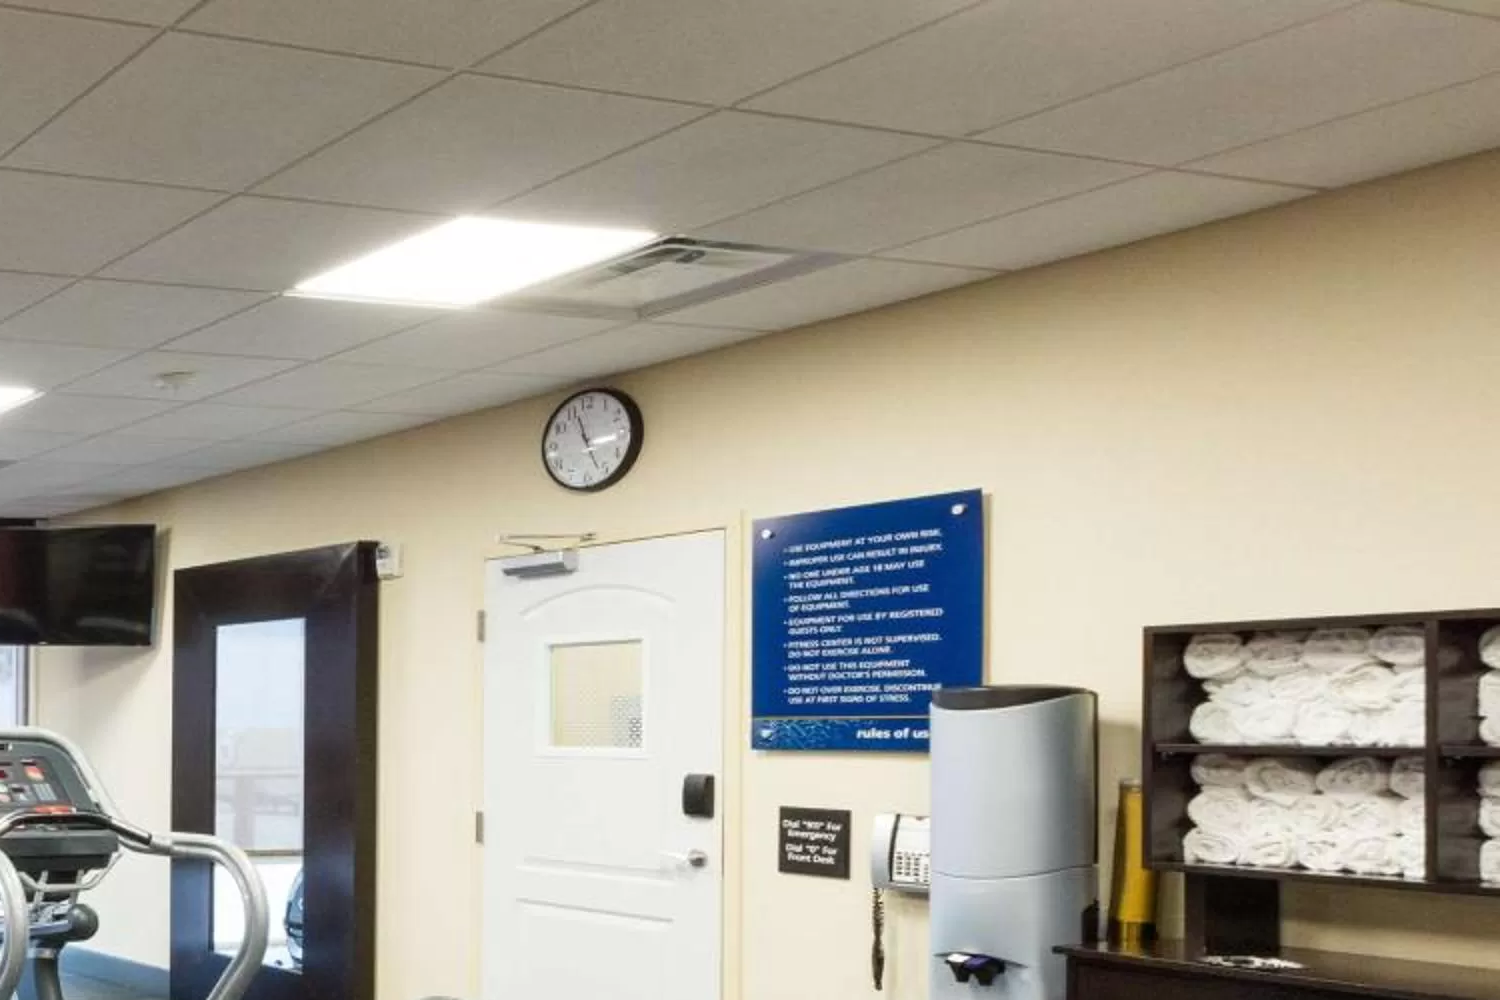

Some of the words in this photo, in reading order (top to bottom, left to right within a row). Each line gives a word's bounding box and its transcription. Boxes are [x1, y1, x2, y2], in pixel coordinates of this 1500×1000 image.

[581, 396, 593, 411] 12
[603, 398, 608, 412] 1
[567, 405, 577, 421] 11
[555, 421, 567, 435] 10
[788, 545, 803, 553] USE
[805, 539, 852, 551] EQUIPMENT
[854, 537, 865, 545] AT
[867, 534, 893, 544] YOUR
[894, 531, 918, 541] OWN
[788, 555, 828, 567] IMPROPER
[830, 553, 845, 562] USE
[846, 551, 865, 561] CAN
[866, 548, 896, 558] RESULT
[898, 547, 908, 555] IN
[803, 570, 820, 579] ONE
[821, 567, 850, 577] UNDER
[852, 565, 870, 574] AGE
[873, 563, 883, 572] 18
[884, 561, 906, 571] MAY
[907, 559, 925, 569] USE
[788, 581, 804, 590] THE
[788, 592, 823, 603] FOLLOW
[823, 591, 838, 600] ALL
[840, 586, 890, 598] DIRECTIONS
[892, 585, 910, 594] FOR
[911, 583, 930, 592] USE
[788, 604, 799, 613] OF
[788, 615, 836, 626] EQUIPMENT
[837, 613, 854, 623] FOR
[856, 612, 872, 621] USE
[875, 611, 887, 620] BY
[889, 607, 944, 618] REGISTERED
[788, 626, 818, 635] GUESTS
[788, 640, 819, 649] FITNESS
[820, 637, 852, 647] CENTER
[853, 637, 862, 645] IS
[863, 636, 884, 644] NOT
[788, 650, 801, 659] DO
[803, 649, 820, 657] NOT
[821, 647, 860, 656] EXERCISE
[802, 663, 820, 671] NOT
[821, 662, 837, 670] USE
[839, 661, 858, 670] THIS
[859, 659, 911, 669] EQUIPMENT
[788, 672, 826, 681] WITHOUT
[827, 670, 870, 680] DOCTOR'S
[788, 687, 801, 695] DO
[801, 686, 819, 694] NOT
[819, 685, 842, 694] OVER
[883, 683, 942, 692] DISCONTINUE
[788, 697, 803, 705] USE
[805, 696, 816, 704] AT
[816, 695, 838, 704] FIRST
[839, 695, 865, 703] SIGNS
[866, 694, 879, 702] OF
[856, 728, 891, 739] rules
[893, 727, 910, 739] of
[912, 730, 930, 739] us
[782, 819, 800, 828] Dial
[787, 829, 837, 842] Emergency
[785, 843, 803, 852] Dial
[787, 852, 811, 862] Front
[813, 854, 836, 865] Desk
